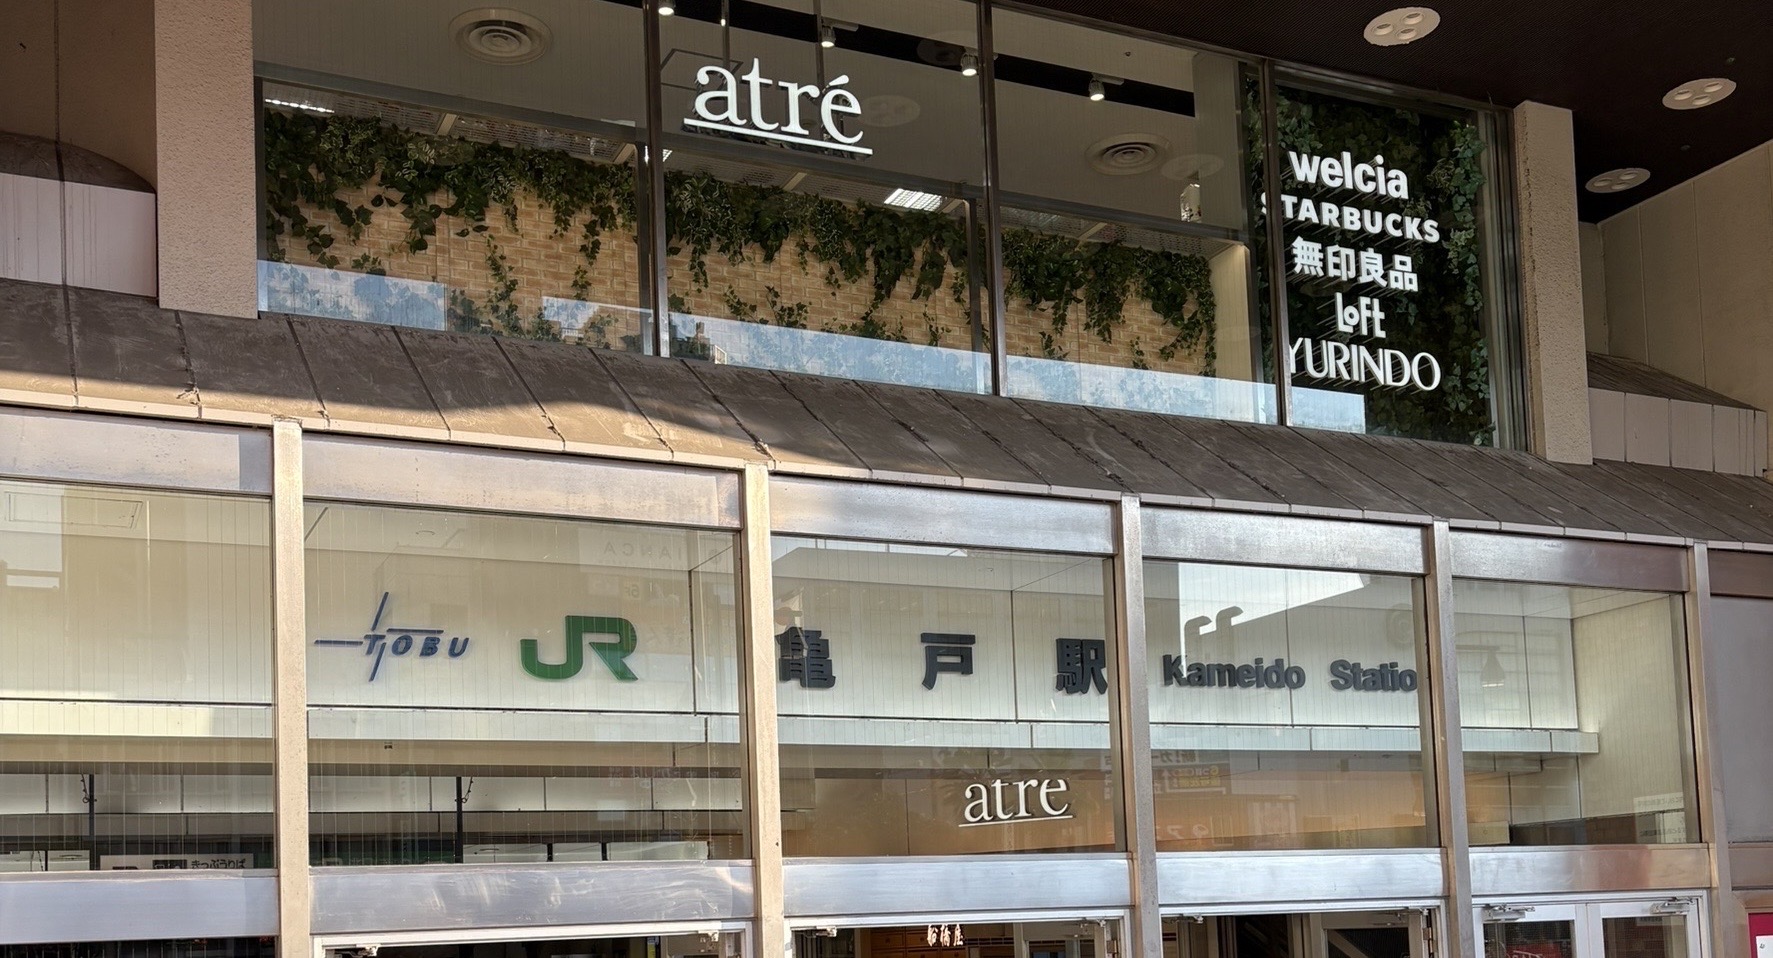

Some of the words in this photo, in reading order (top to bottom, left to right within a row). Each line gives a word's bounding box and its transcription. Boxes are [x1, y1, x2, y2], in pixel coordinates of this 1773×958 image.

[694, 57, 865, 145] atré
[1287, 151, 1409, 200] welcia
[1291, 236, 1419, 292] 無印良品
[1289, 337, 1442, 391] YURINDO
[362, 633, 471, 659] TOBU
[519, 614, 639, 681] JR
[774, 626, 1109, 695] 亀戸駅
[1162, 654, 1307, 690] Kameido
